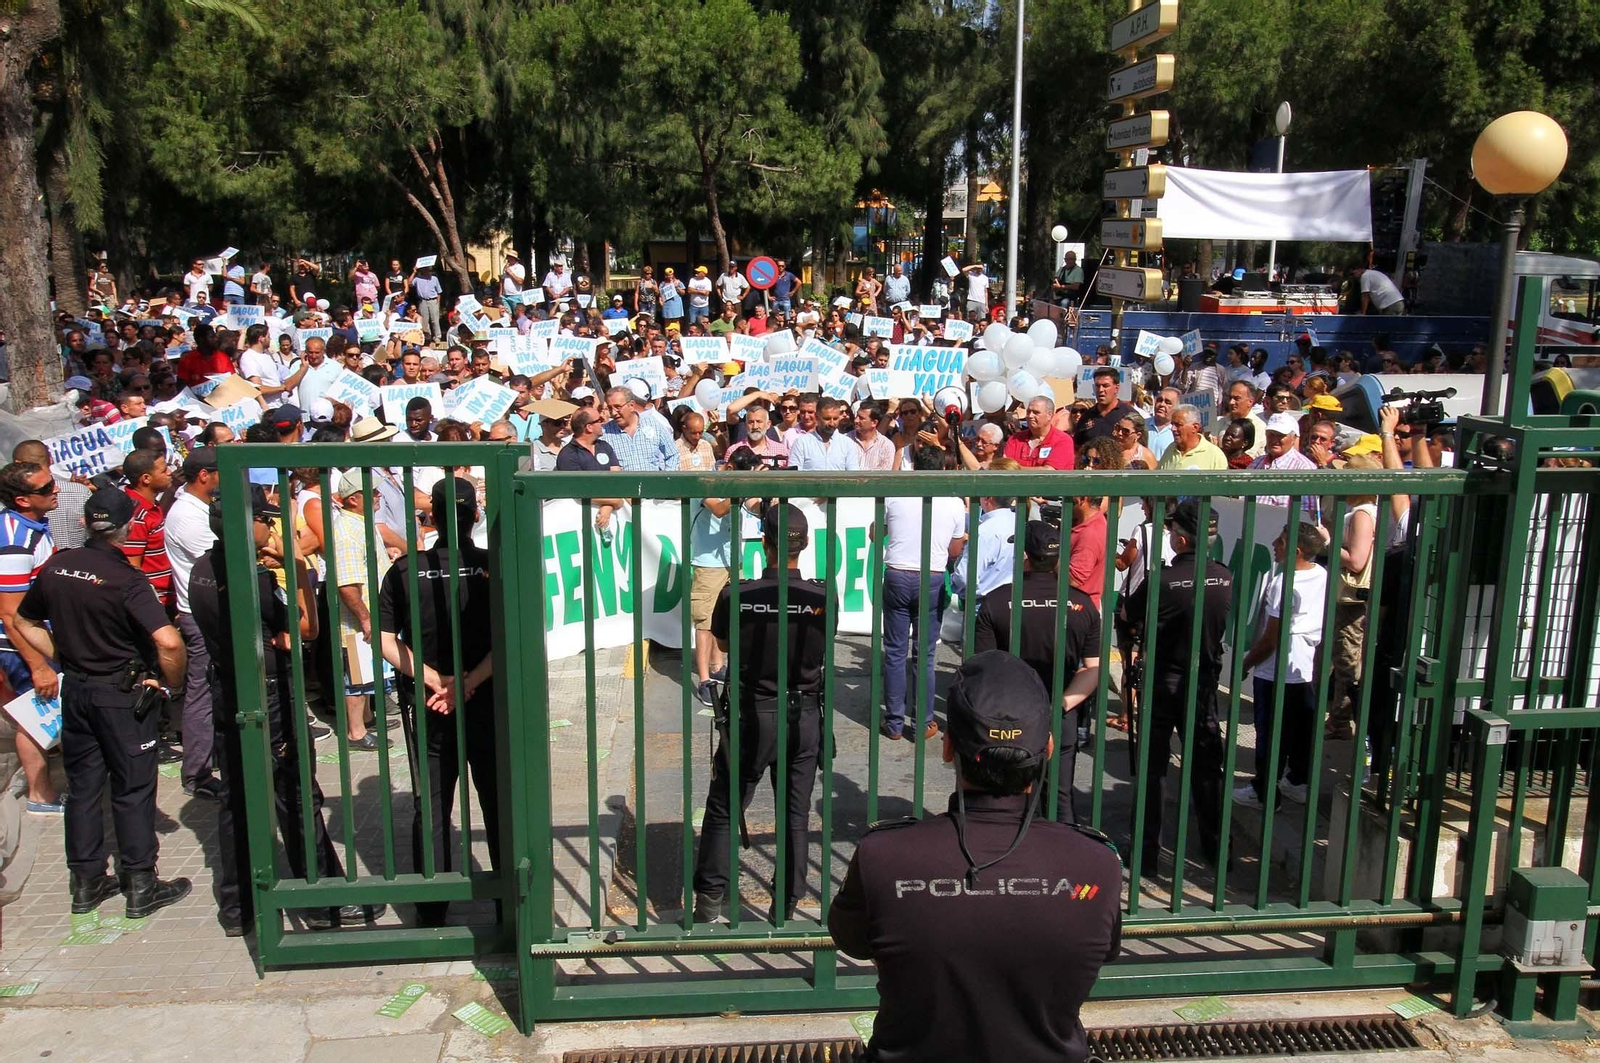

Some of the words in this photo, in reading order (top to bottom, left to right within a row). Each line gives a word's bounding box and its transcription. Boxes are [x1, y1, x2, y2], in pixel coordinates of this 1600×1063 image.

[417, 567, 485, 579] POLCIA
[740, 602, 815, 614] POLCIA
[989, 728, 1023, 741] CNP
[895, 877, 1077, 899] POLICIA
